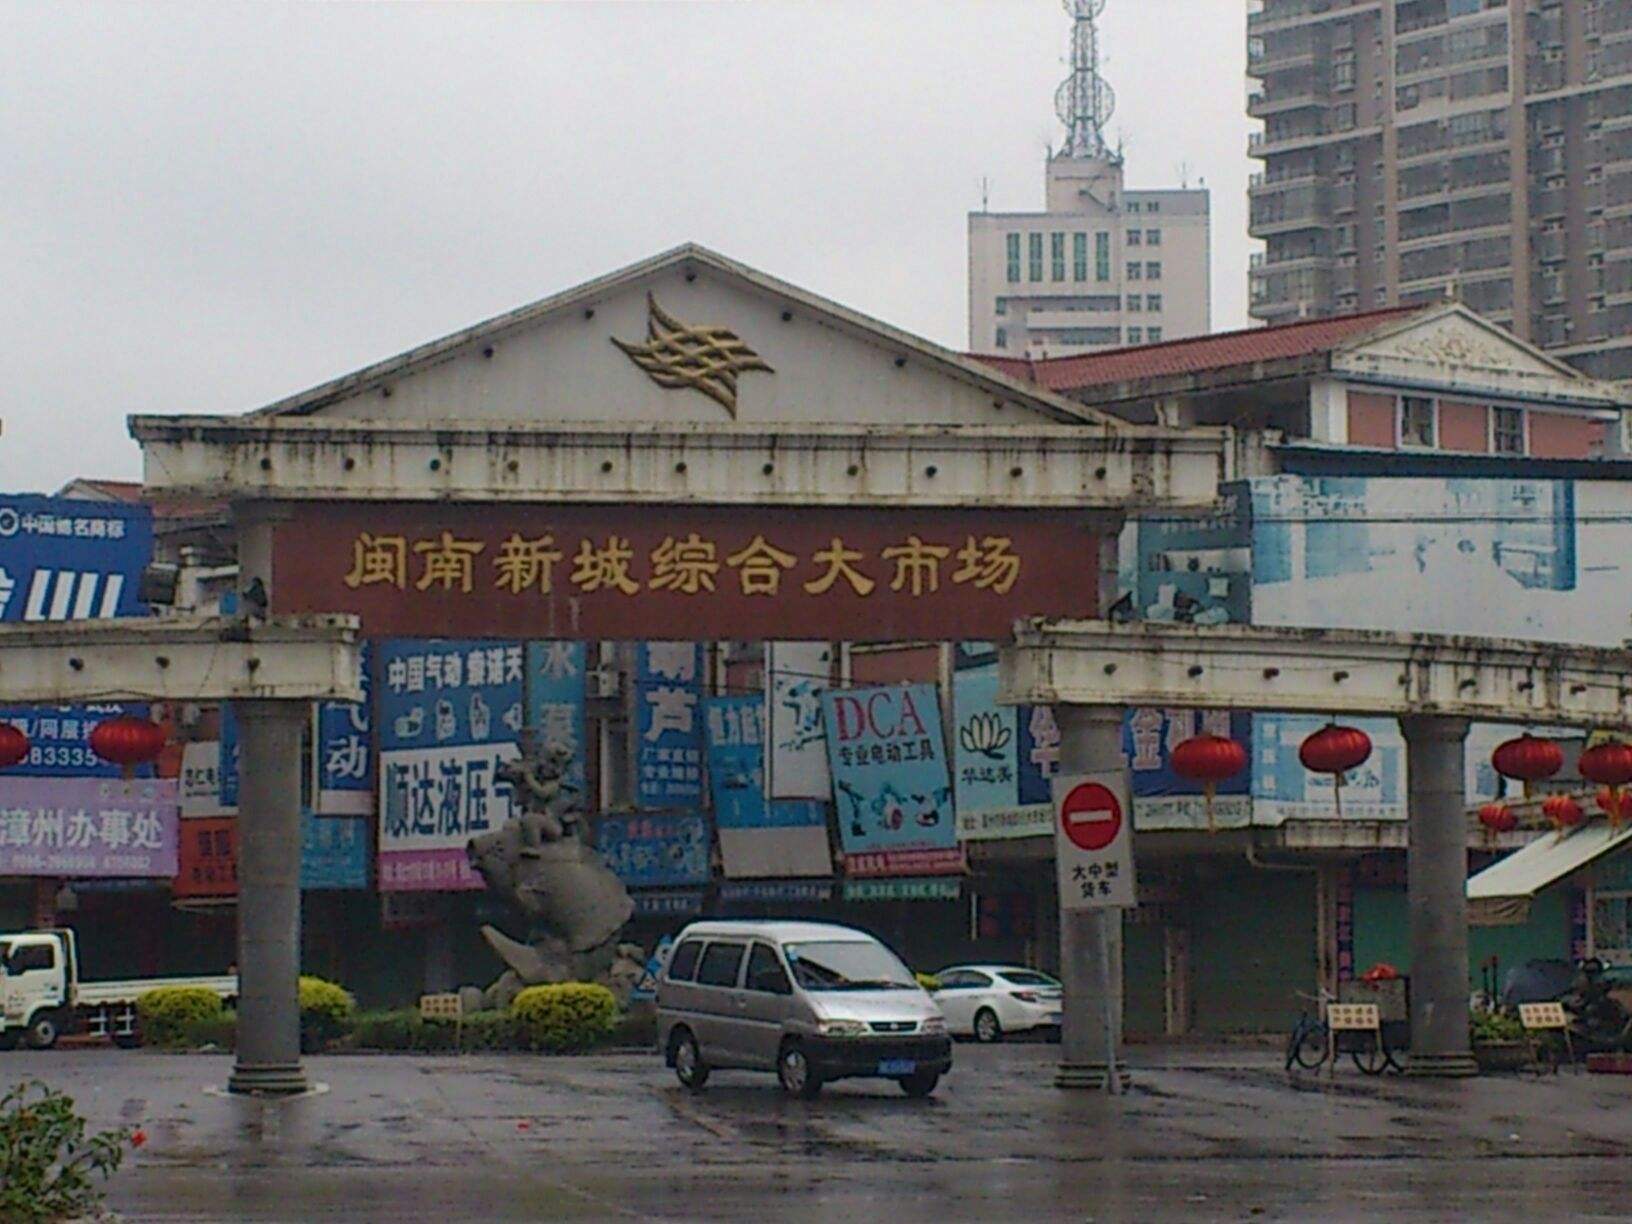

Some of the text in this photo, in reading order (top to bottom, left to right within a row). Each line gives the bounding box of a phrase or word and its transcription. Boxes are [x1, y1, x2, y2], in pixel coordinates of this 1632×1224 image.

[344, 530, 1022, 597] 闽南新城综合大市场
[388, 650, 463, 693] 中国气动
[833, 690, 928, 741] DCA
[838, 739, 935, 766] 专业电动工具
[0, 808, 163, 849] 漳州办事处
[1072, 861, 1119, 881] 大中型
[1081, 880, 1112, 898] 货车
